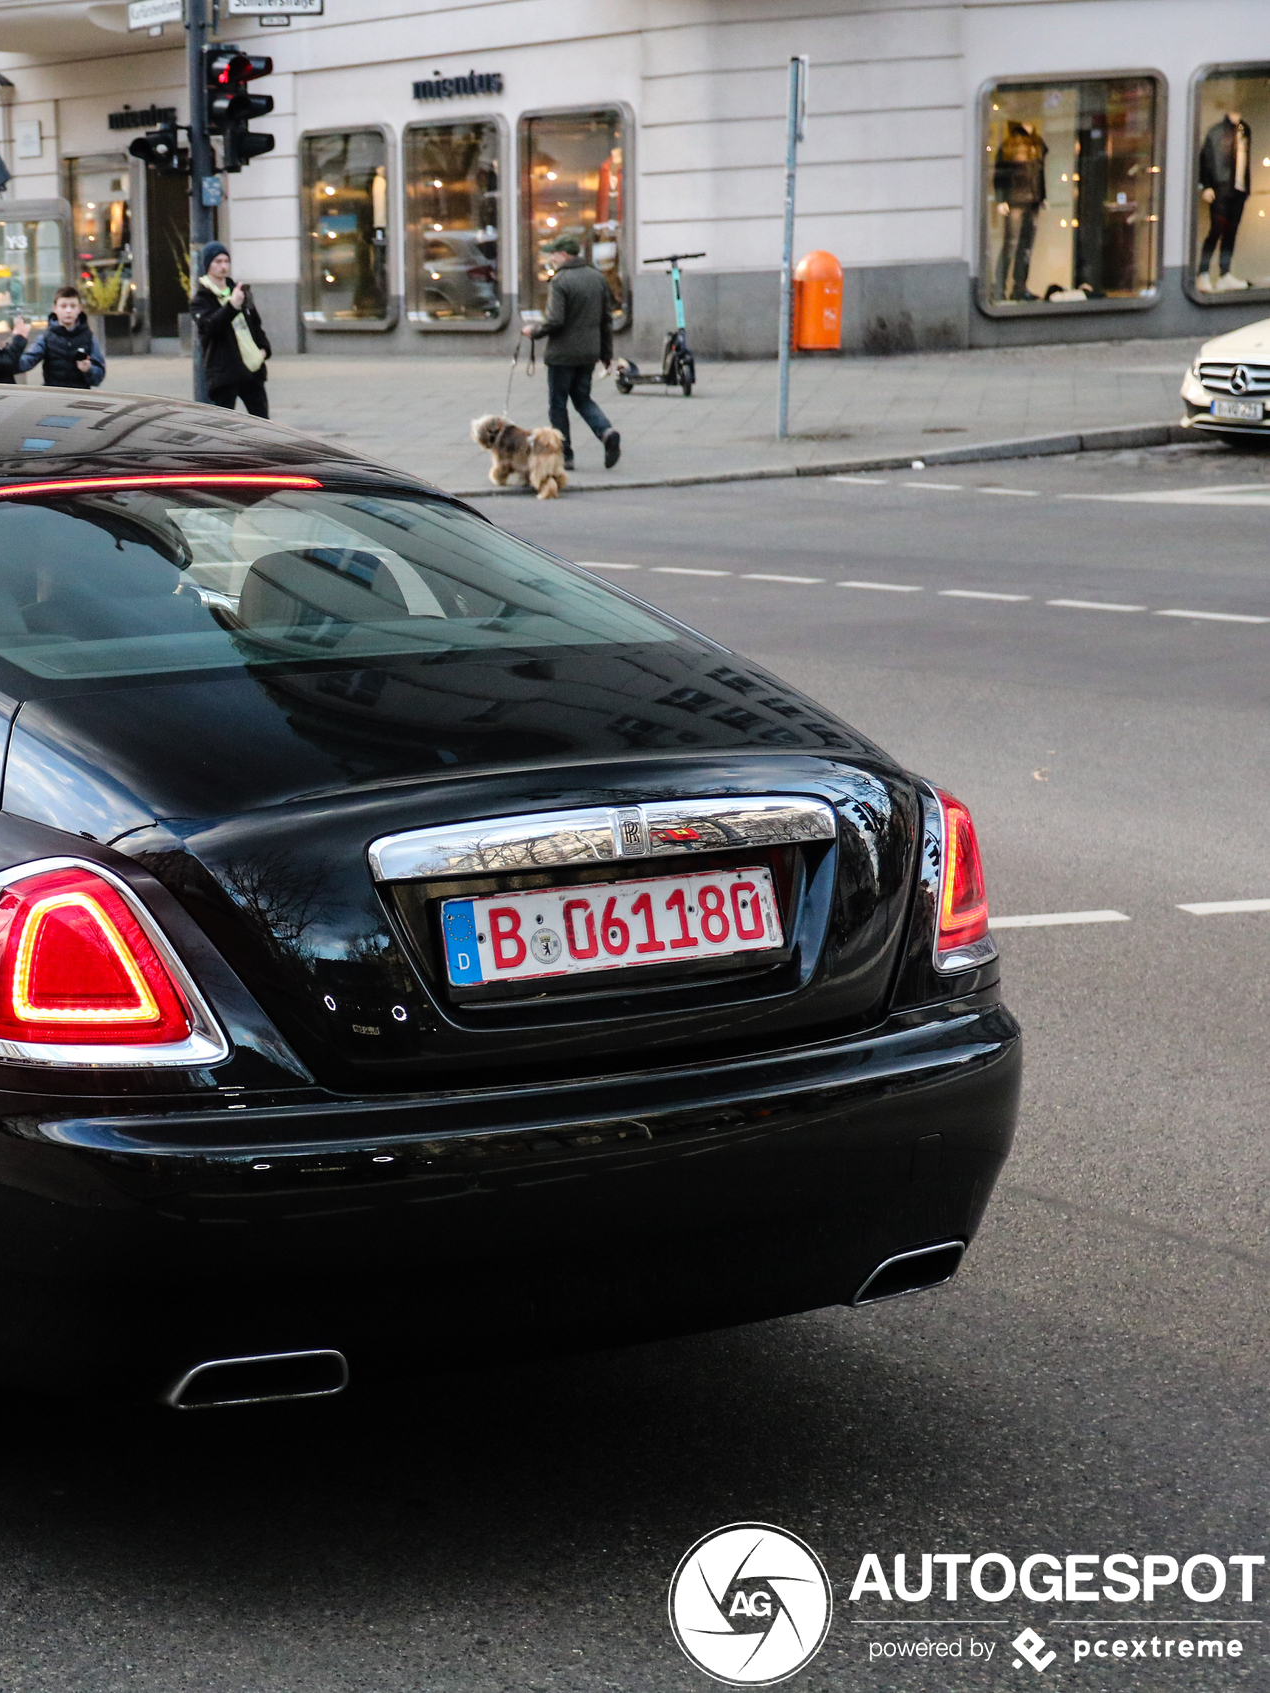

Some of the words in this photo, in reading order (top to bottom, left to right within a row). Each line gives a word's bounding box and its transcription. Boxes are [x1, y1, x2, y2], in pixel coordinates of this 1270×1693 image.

[488, 907, 527, 970] B
[562, 881, 765, 960] 061180
[457, 953, 471, 970] D
